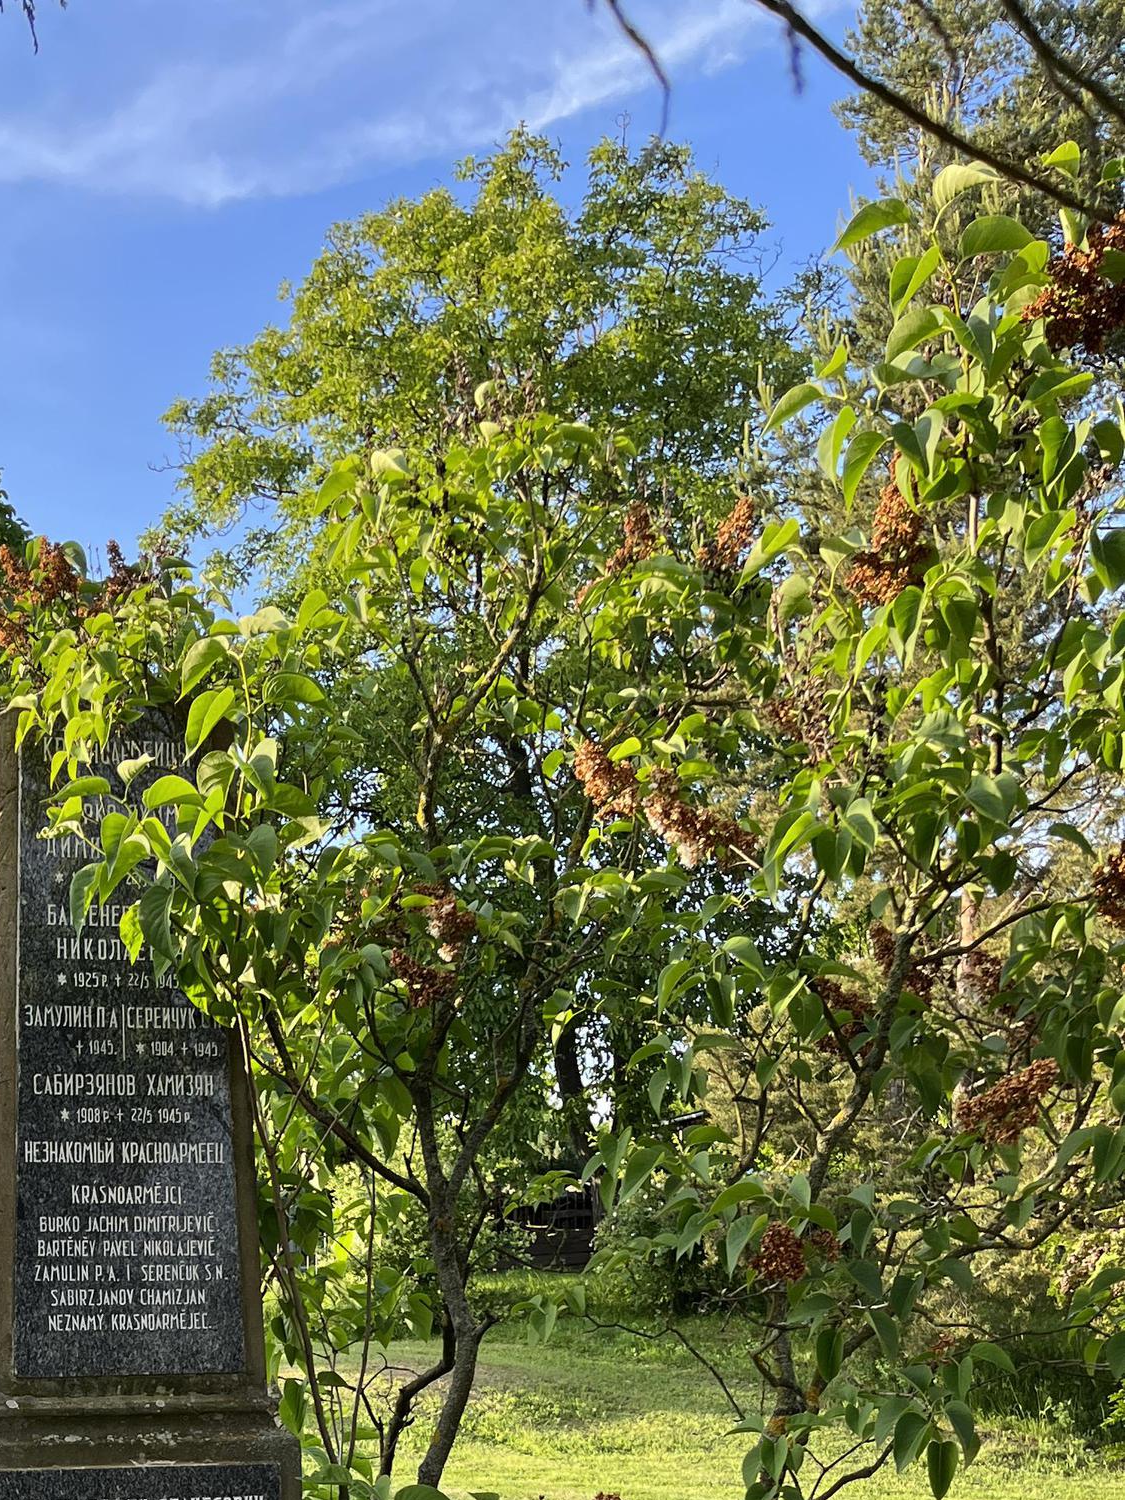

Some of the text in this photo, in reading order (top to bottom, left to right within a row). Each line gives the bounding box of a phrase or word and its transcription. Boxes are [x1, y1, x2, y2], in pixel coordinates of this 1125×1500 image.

[73, 972, 99, 988] 1925
[128, 971, 149, 989] 22/5
[156, 973, 180, 989] 1945
[24, 1004, 92, 1028] ЗАМУЛИН
[33, 1073, 214, 1096] САБИРЗЯНОВ ХАМИЗЯН
[76, 1108, 101, 1123] 1908
[131, 1106, 153, 1124] 22/5
[157, 1108, 182, 1123] 1945
[122, 1141, 226, 1165] КРАСНОАРМЕЕЦ
[39, 1215, 80, 1233] BURKO
[85, 1215, 129, 1233] JACHIM
[103, 1240, 138, 1257] PAVEL
[34, 1264, 89, 1282] ZAMULIN
[141, 1260, 199, 1282] SERENČUK
[51, 1288, 134, 1307] SABIRZJANOV
[48, 1309, 105, 1332] NEZNAMÝ
